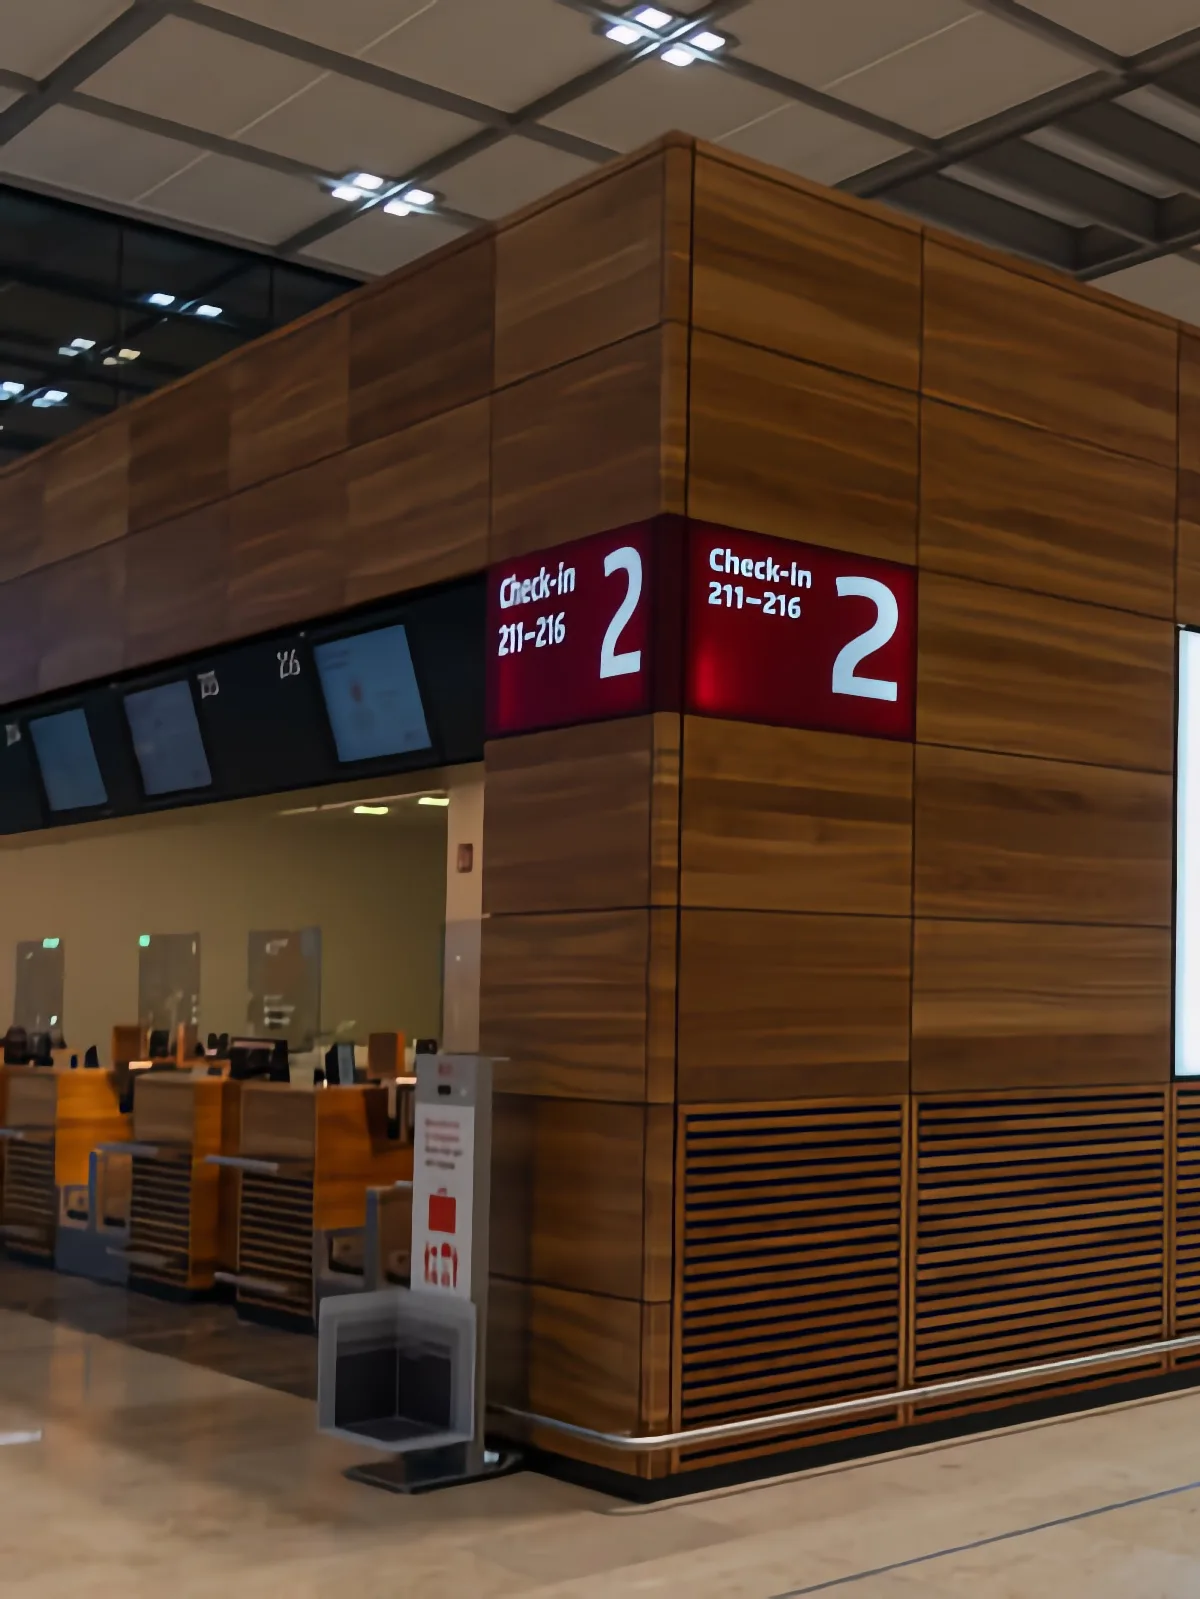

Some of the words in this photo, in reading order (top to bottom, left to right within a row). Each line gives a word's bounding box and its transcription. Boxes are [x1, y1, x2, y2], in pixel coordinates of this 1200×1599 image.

[500, 562, 575, 609] Check-in
[709, 548, 812, 589] Check-in
[599, 546, 643, 679] 2
[831, 576, 899, 702] 2
